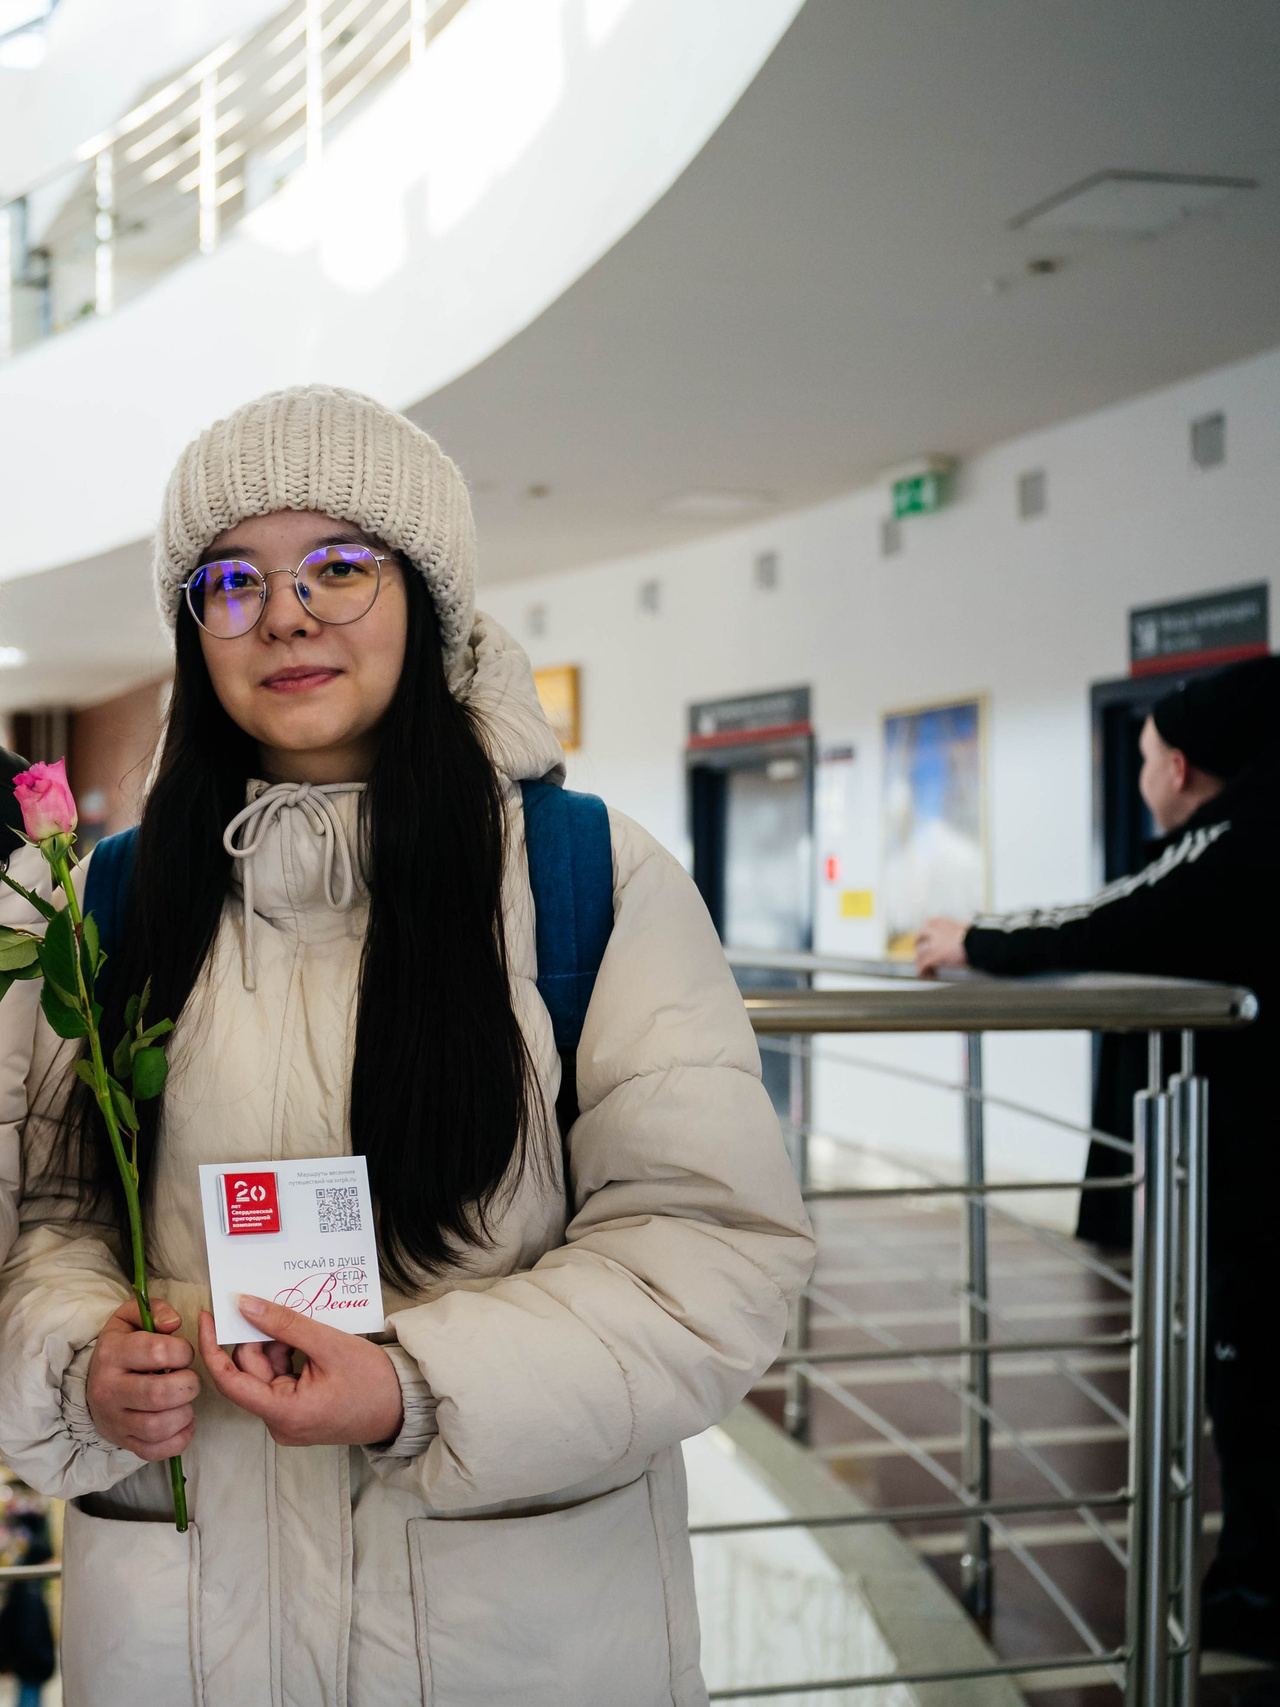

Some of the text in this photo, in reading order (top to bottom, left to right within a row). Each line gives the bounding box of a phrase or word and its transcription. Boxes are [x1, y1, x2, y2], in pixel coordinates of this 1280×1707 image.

[234, 1180, 266, 1202] 20
[283, 1256, 366, 1270] ПУСКАЙ В ДУШЕ
[329, 1270, 368, 1281] ВСЕГДА
[342, 1283, 369, 1294] ПОЕТ
